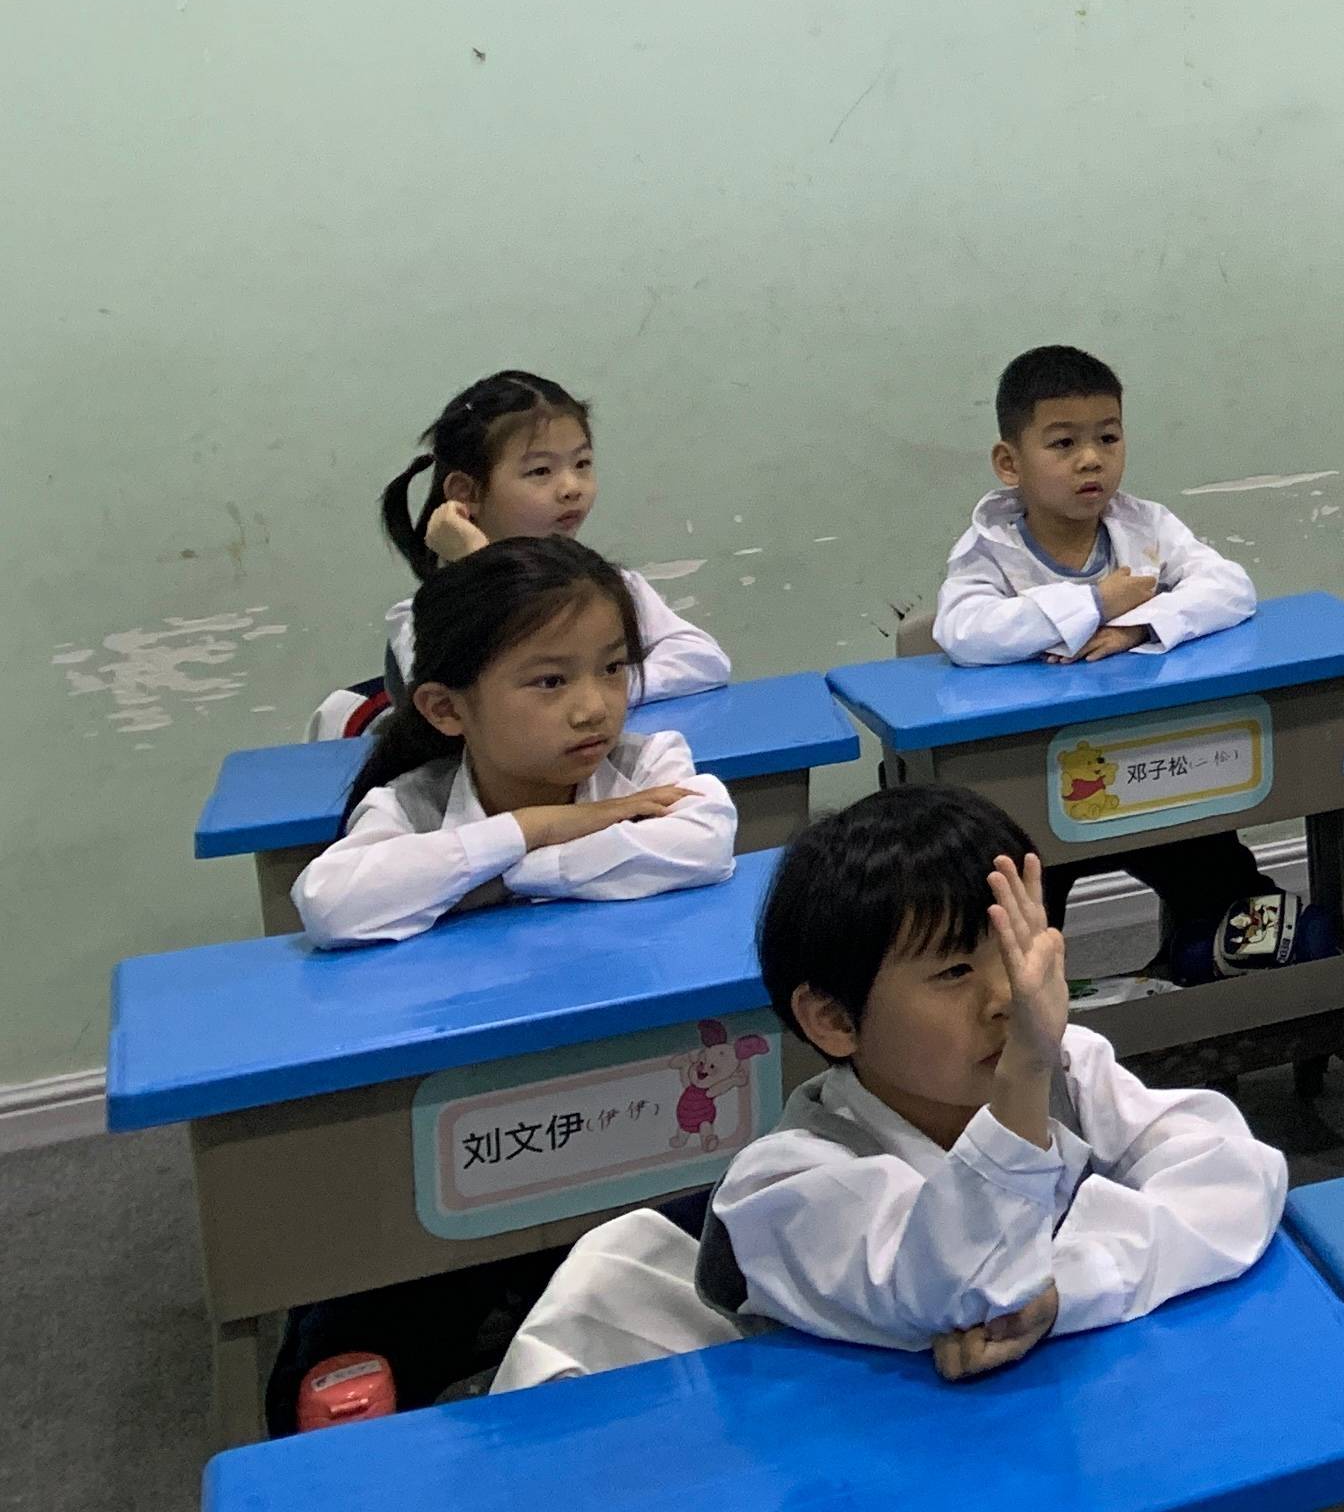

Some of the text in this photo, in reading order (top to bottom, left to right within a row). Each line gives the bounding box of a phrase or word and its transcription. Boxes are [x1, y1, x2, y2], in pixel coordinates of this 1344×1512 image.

[1127, 755, 1188, 784] 邓子松
[462, 1111, 585, 1170] 刘文伊
